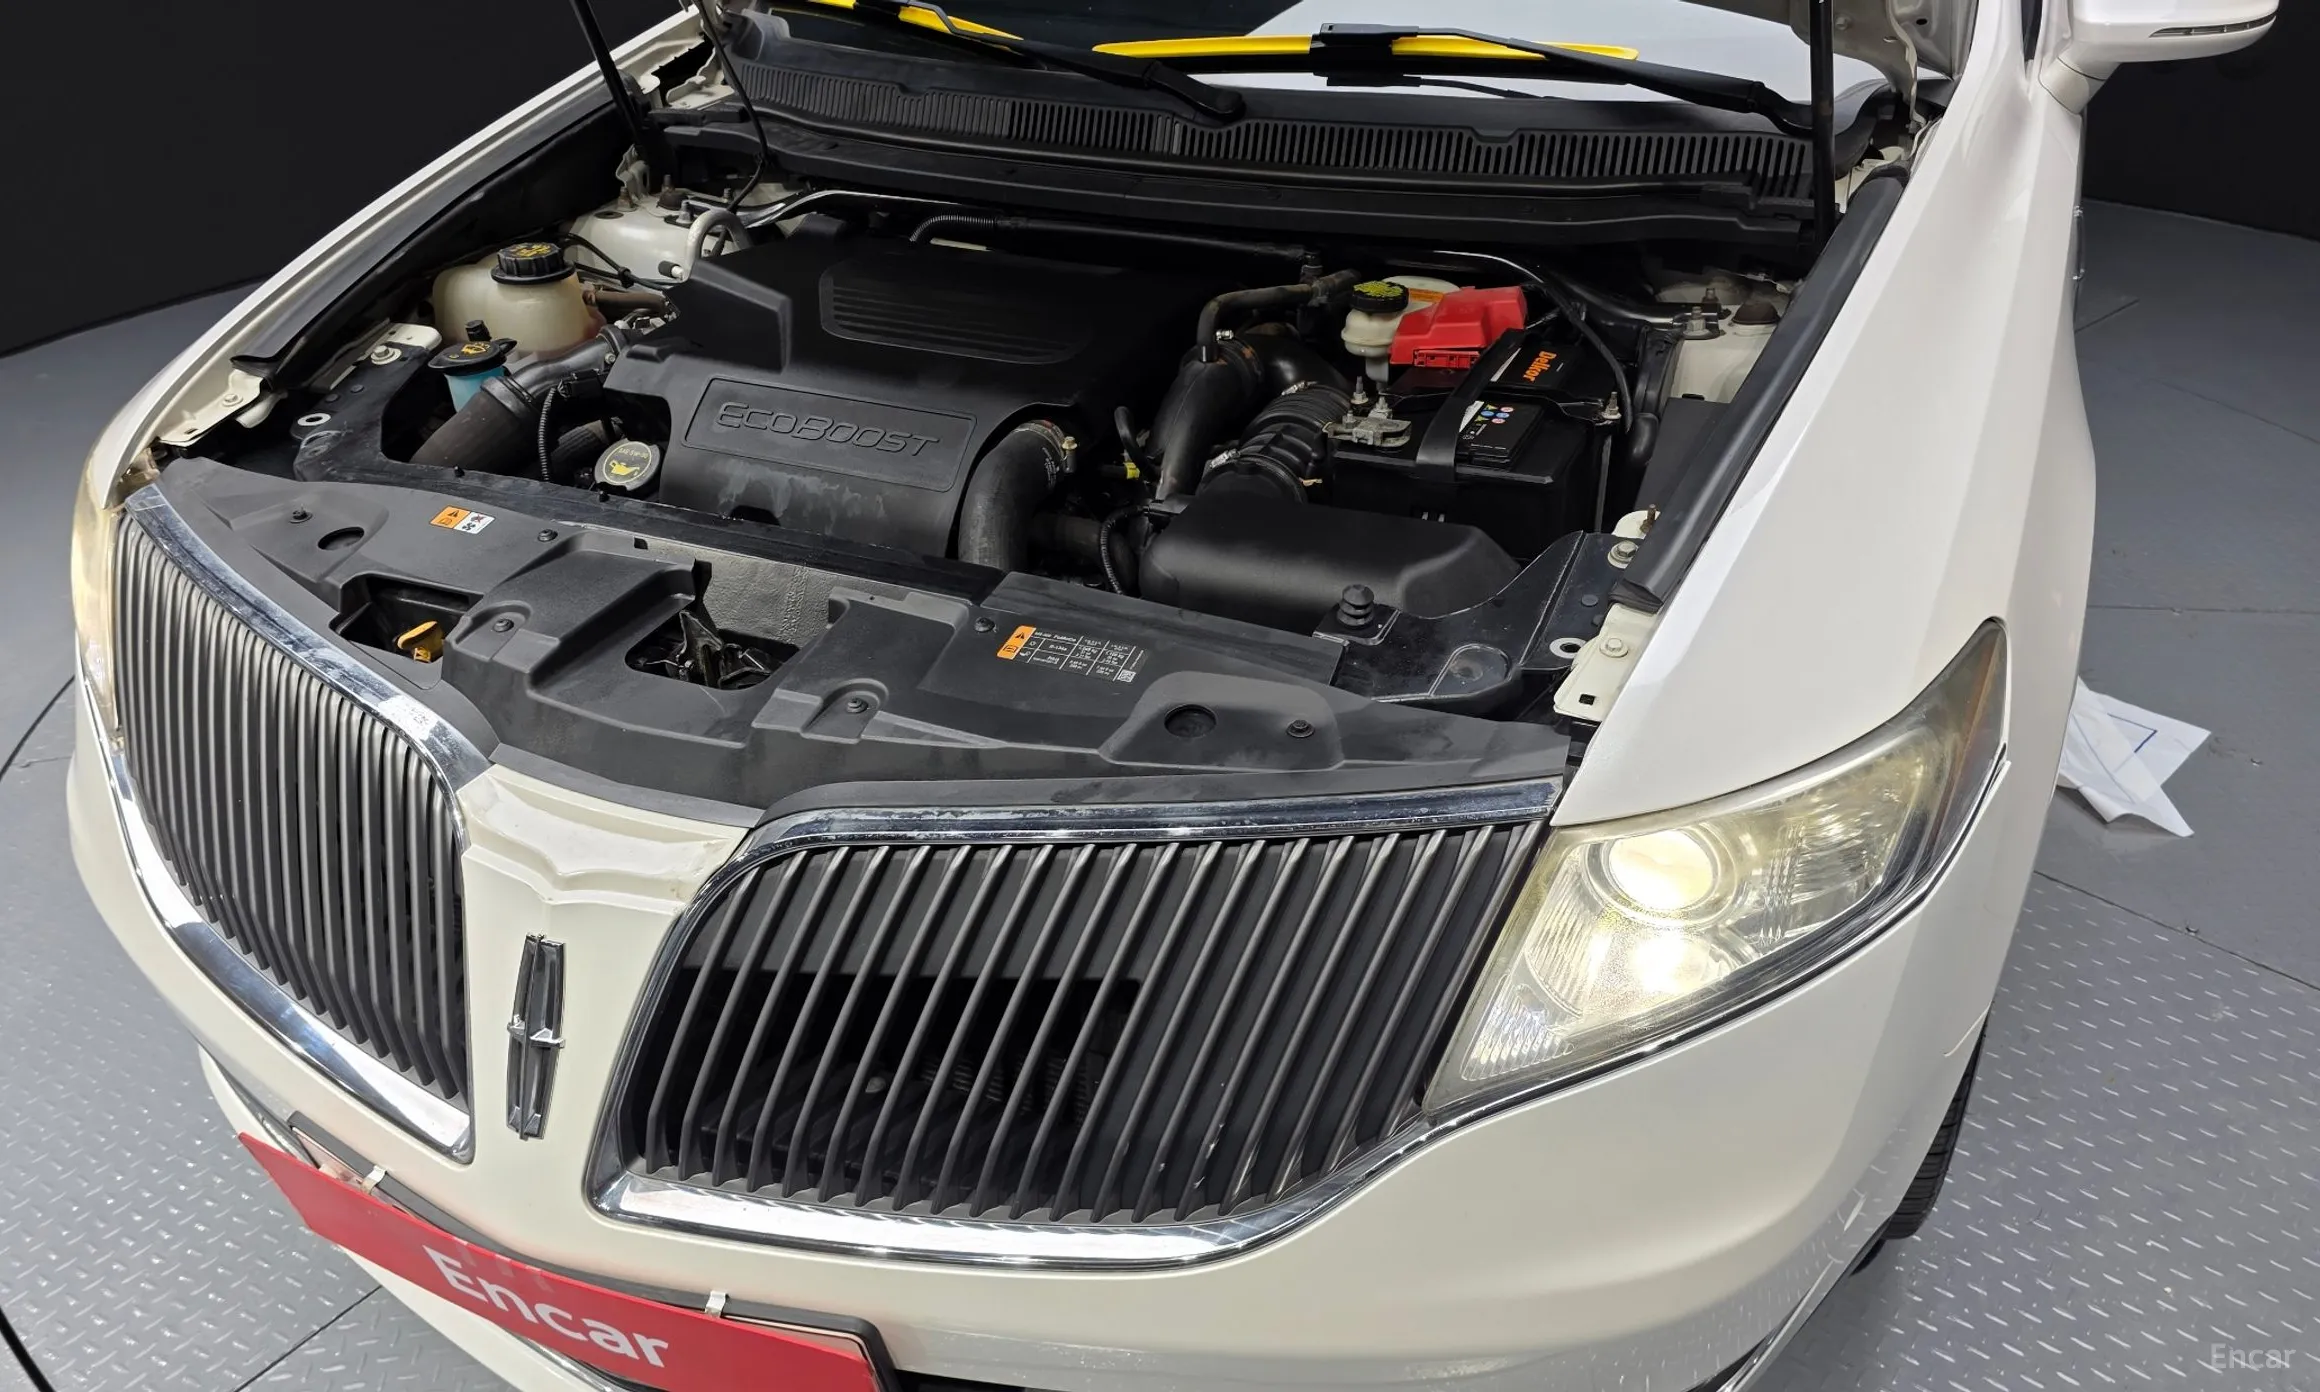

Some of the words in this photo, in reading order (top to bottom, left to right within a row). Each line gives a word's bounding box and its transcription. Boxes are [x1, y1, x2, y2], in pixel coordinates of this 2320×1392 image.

[1523, 351, 1557, 382] Delkor
[714, 401, 940, 457] ECOBOOST
[422, 1244, 669, 1368] Encar
